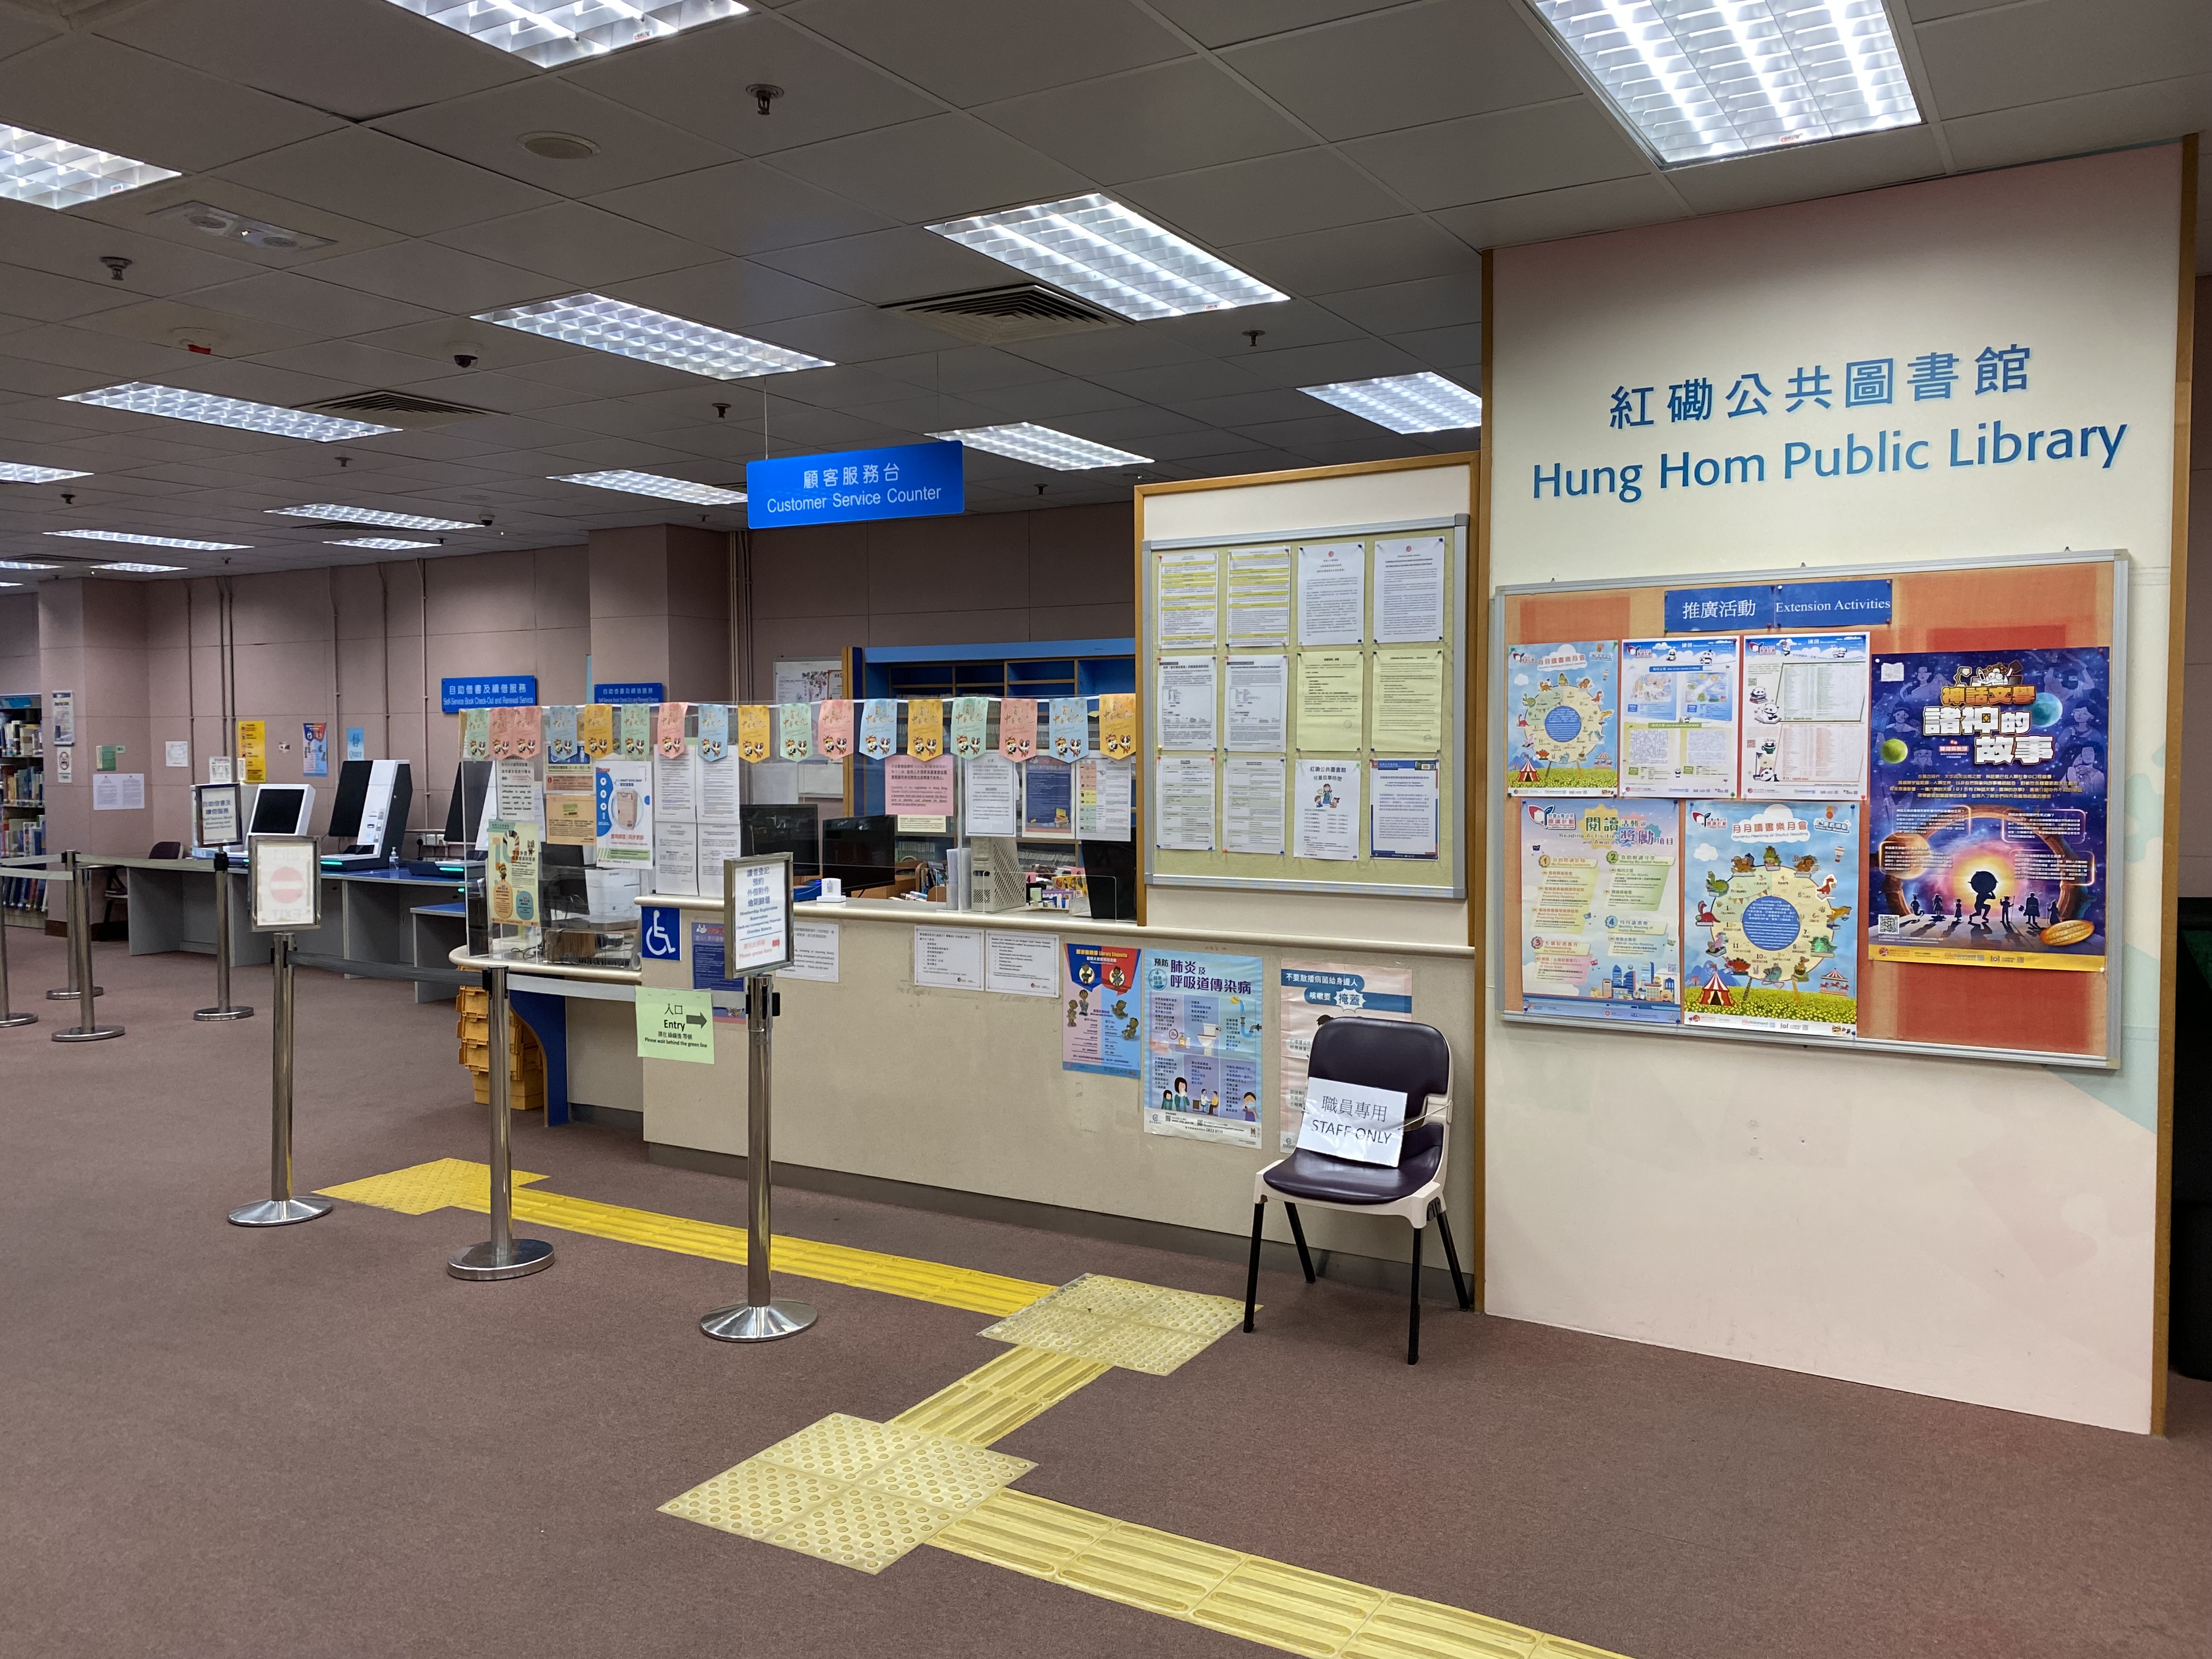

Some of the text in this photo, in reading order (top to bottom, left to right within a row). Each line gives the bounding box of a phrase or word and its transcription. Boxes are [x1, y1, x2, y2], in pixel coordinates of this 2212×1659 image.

[1609, 343, 2032, 430] 紅磡公共圖書館
[1534, 419, 2128, 503] Hung Hom Public Library
[803, 462, 900, 489] 顧客服務台
[768, 486, 941, 513] Customer Service Counter
[1682, 598, 1891, 620] 推廣活動 Extension Activities
[449, 683, 526, 695] 自助借書及續借服務
[1974, 735, 2055, 765] 故事
[1585, 816, 1618, 832] 閱讀
[1733, 821, 1808, 833] 月月讀書樂月會
[1621, 830, 1655, 845] 獎勵
[1154, 958, 1206, 975] 預防 肺炎及
[1170, 974, 1252, 994] 呼吸道傳染病
[1285, 973, 1358, 988] 不要散播病菌給身邊人
[1338, 992, 1361, 1007] 掩蓋
[663, 1019, 685, 1031] Entry
[1321, 1095, 1387, 1122] 職員專用
[1310, 1119, 1392, 1144] STAFF ONLY
